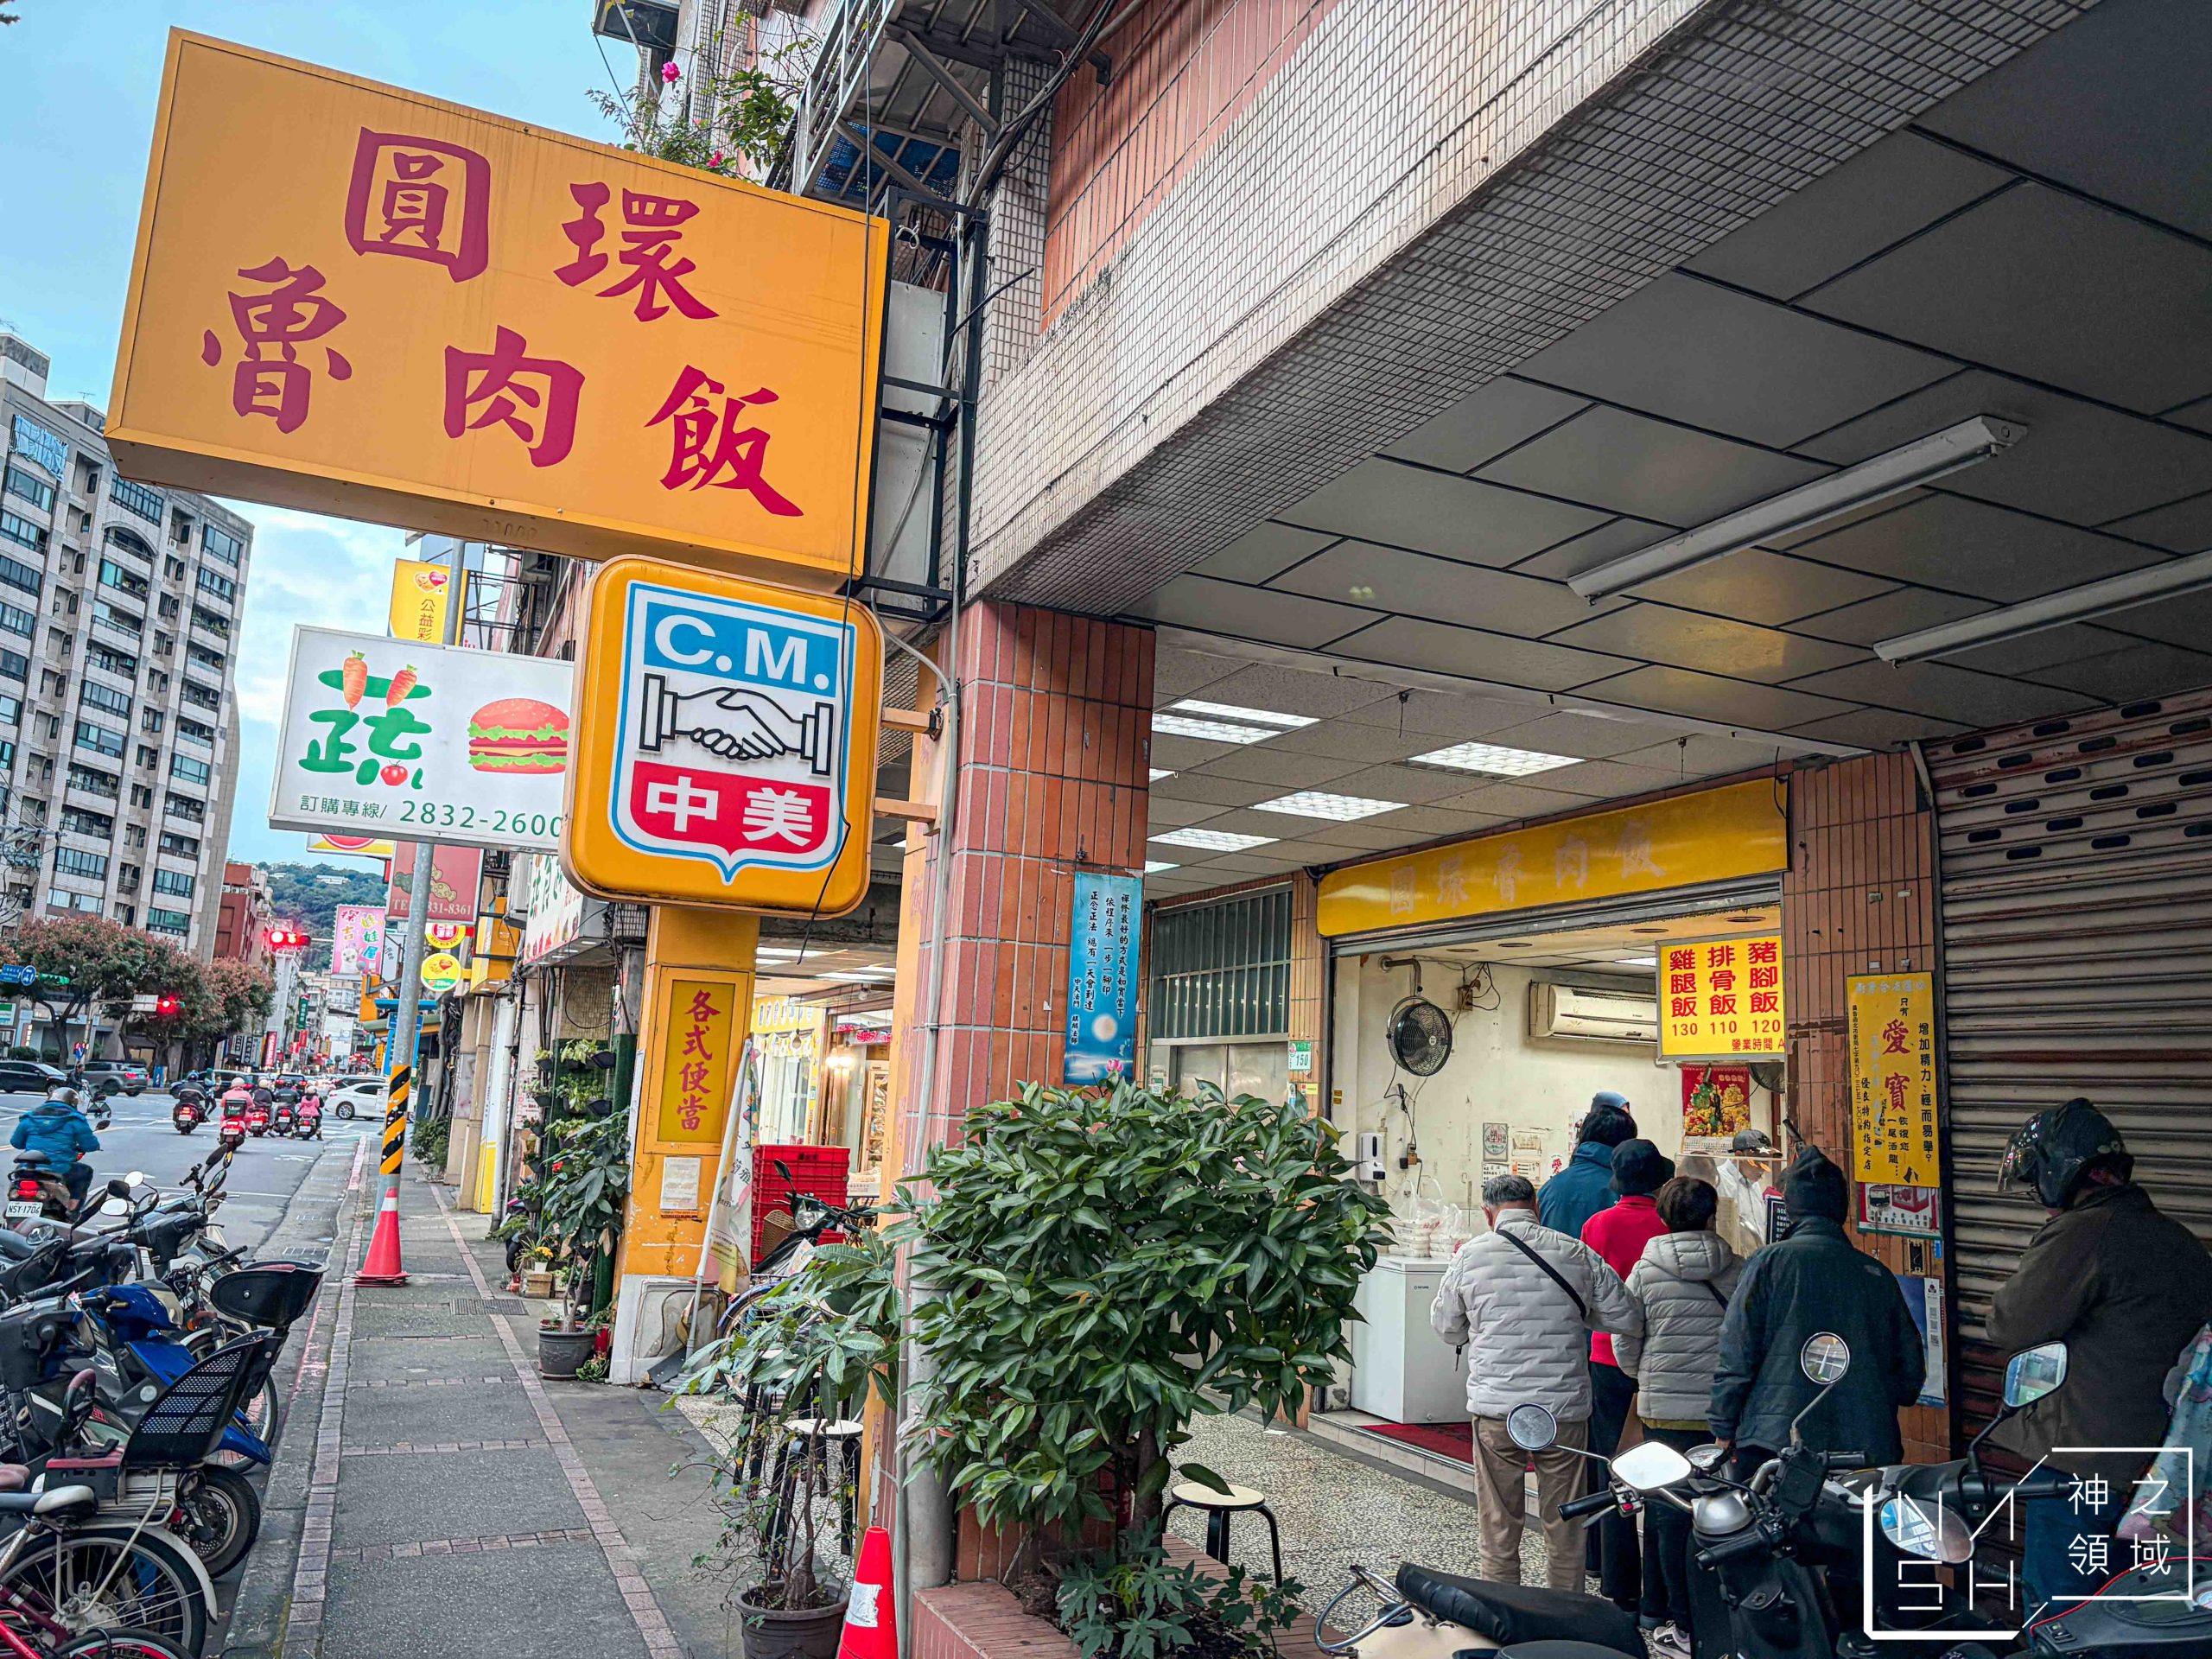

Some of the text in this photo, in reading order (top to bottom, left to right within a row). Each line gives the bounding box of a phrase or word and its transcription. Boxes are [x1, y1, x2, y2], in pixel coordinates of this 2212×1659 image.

[345, 127, 719, 321] 圓環
[202, 256, 804, 517] 魯肉飯
[655, 614, 830, 690] C.M.
[645, 777, 812, 846] 中美
[1669, 948, 1697, 1018] 雞腿飯
[1707, 944, 1737, 1016] 排骨飯
[1747, 941, 1779, 1014] 豬腳飯
[1900, 997, 1909, 1016] 只有
[677, 989, 721, 1131] 各式便當
[1672, 1019, 1781, 1036] 130 110 120
[1732, 1038, 1773, 1052] 營業時間
[1883, 1018, 1910, 1112] 愛寶
